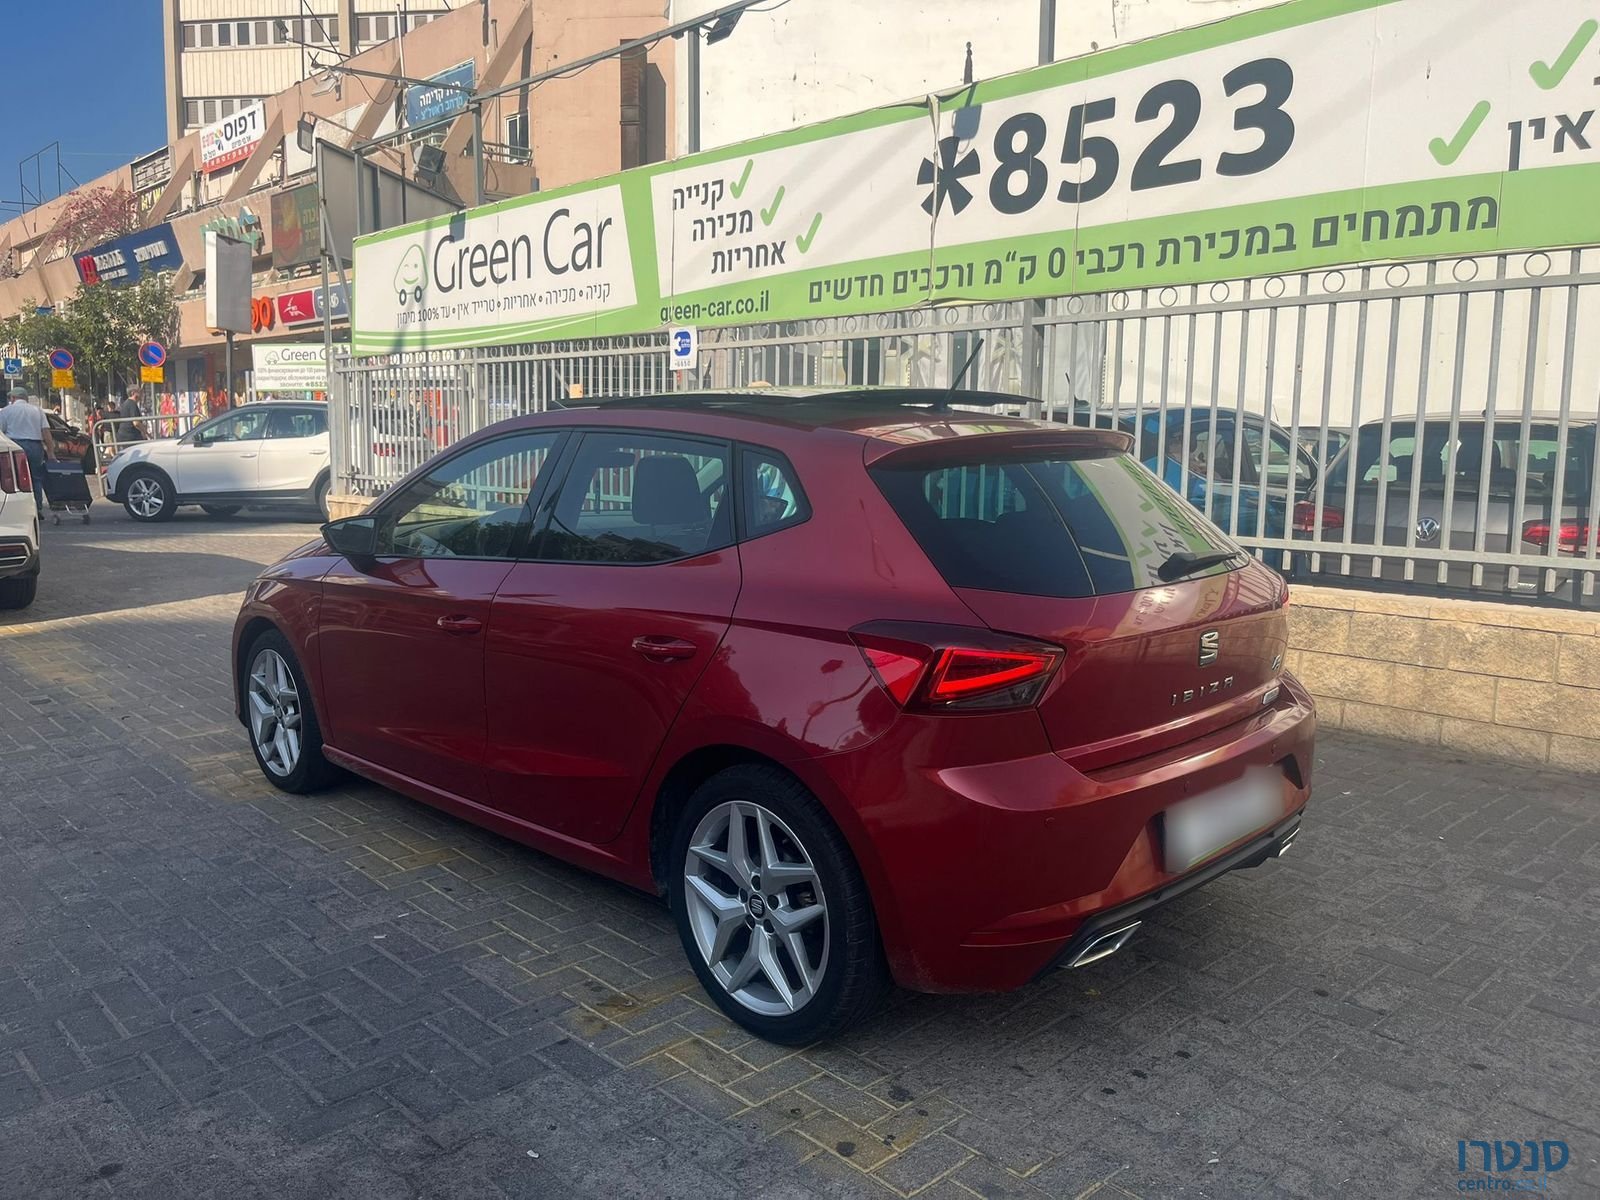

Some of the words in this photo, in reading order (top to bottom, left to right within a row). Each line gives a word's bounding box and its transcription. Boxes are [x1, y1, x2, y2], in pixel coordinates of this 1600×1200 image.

[224, 110, 256, 141] דפוס
[1507, 110, 1595, 171] אין
[673, 179, 724, 211] קנייה
[692, 209, 753, 242] מכירה
[1311, 195, 1498, 248] מתמחים
[433, 234, 532, 294] Green
[543, 208, 612, 275] Car
[711, 240, 786, 274] אחריות
[1076, 241, 1145, 276] רכבי
[1156, 222, 1296, 267] במכירת
[585, 283, 611, 303] קניה
[809, 273, 884, 303] חדשים
[892, 262, 973, 295] ורכבים
[440, 305, 450, 318] עד
[457, 301, 469, 320] אין
[472, 298, 494, 315] טרייד
[503, 292, 536, 311] אחריות
[545, 286, 576, 306] מכירה
[660, 290, 769, 323] green-car.co.il
[418, 307, 439, 322] 100%
[281, 348, 316, 361] Green
[1170, 676, 1234, 706] IBIZA
